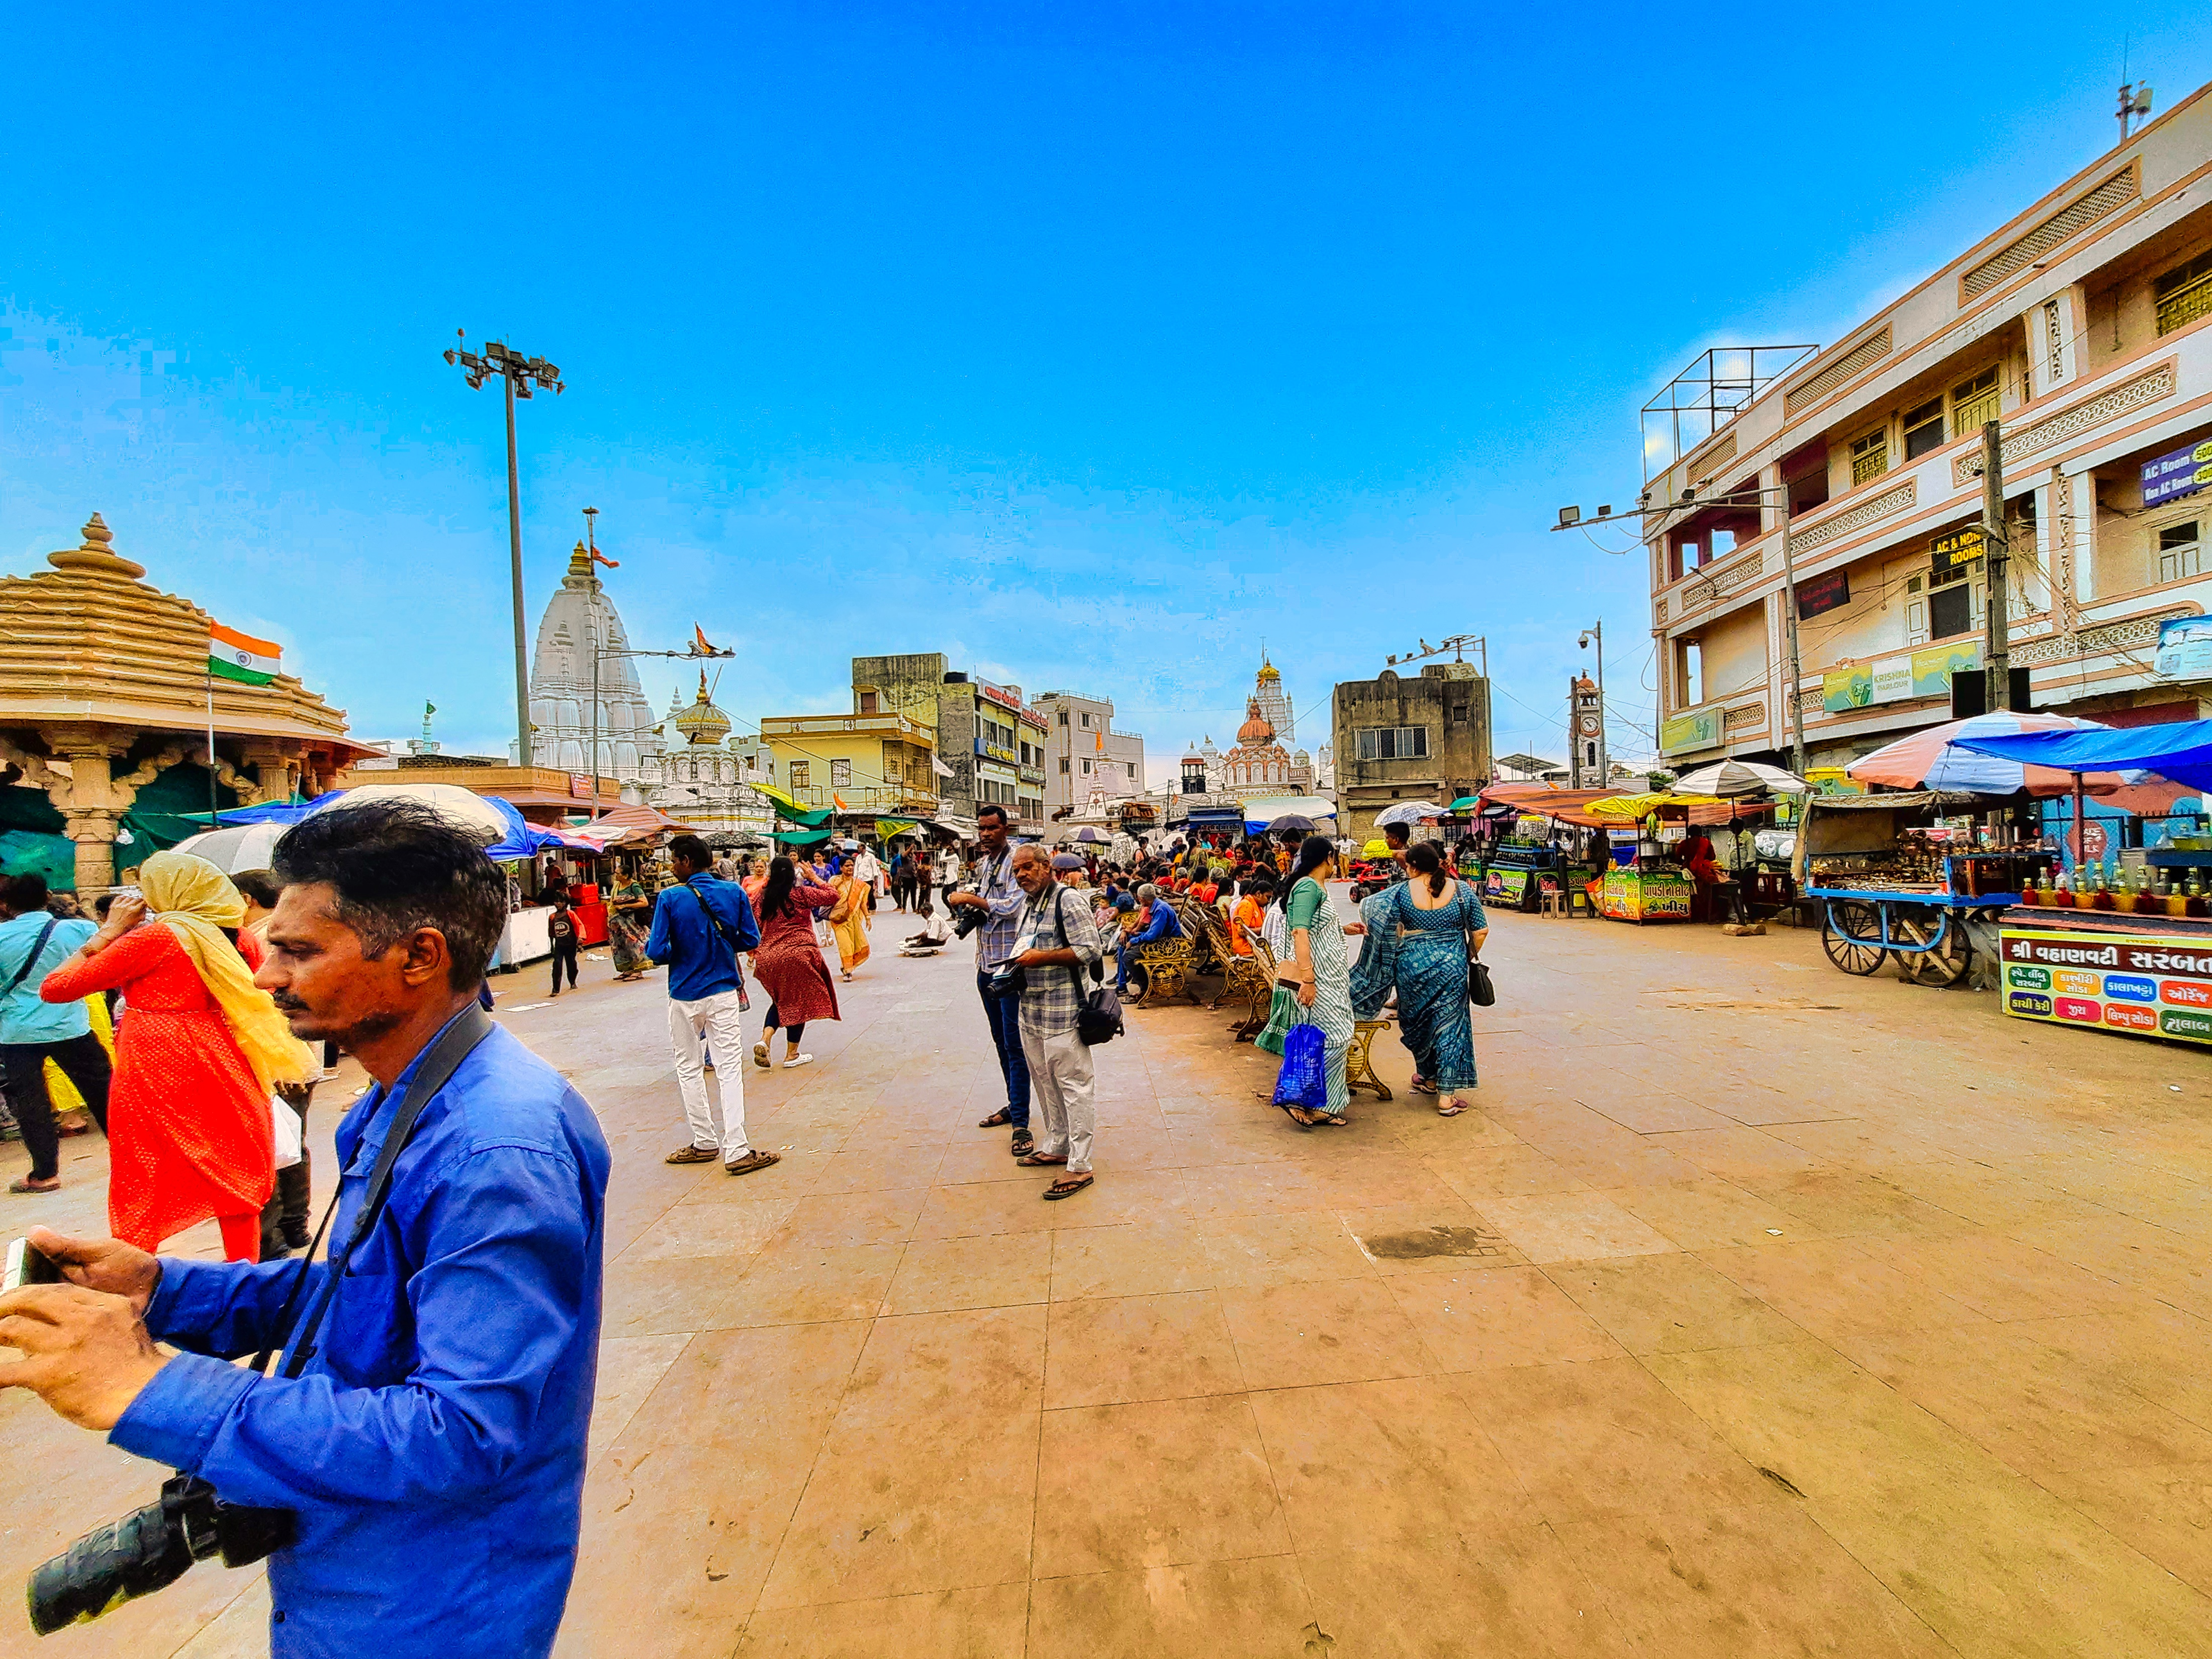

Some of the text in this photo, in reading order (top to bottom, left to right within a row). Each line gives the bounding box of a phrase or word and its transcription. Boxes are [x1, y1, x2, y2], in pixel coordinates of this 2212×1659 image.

[2144, 465, 2159, 481] AC
[2161, 455, 2190, 474] Room
[2160, 481, 2171, 495] AC
[1937, 532, 1981, 554] AC & NON
[1950, 544, 1983, 565] ROOMS
[1874, 669, 1911, 683] KRISHNA
[1877, 680, 1908, 691] PARLOUR
[1675, 881, 1689, 898] લોટ
[1662, 900, 1688, 915] ખીચુ
[2011, 941, 2212, 973] શ્રી વહાણવટી સરબત
[2015, 979, 2042, 988] સરબત
[2066, 983, 2088, 994] સોડા
[2012, 997, 2051, 1012] કાચી કેરી
[2067, 1004, 2086, 1016] જીરા
[2131, 1010, 2154, 1026] સોડા
[2165, 1018, 2210, 1033] ગુલાબ
